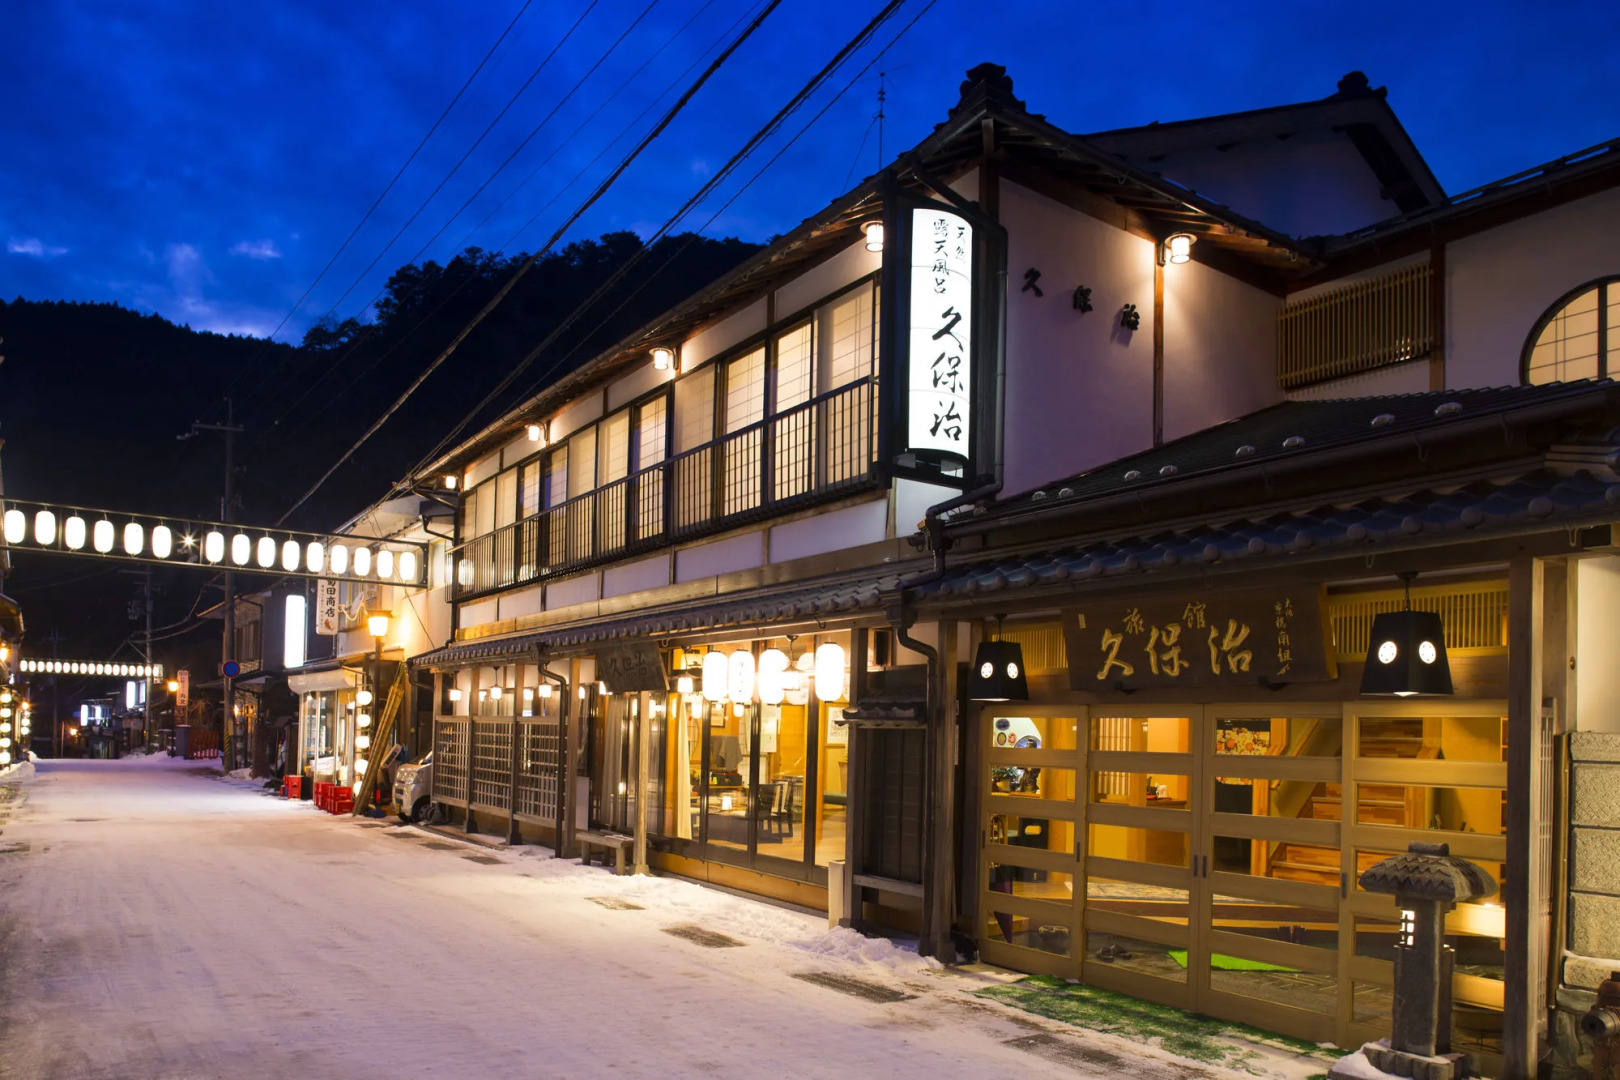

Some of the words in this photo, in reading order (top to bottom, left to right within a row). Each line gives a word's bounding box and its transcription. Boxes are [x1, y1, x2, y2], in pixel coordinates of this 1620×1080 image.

[933, 219, 950, 294] 露天風呂
[1021, 268, 1140, 331] 久保治
[930, 306, 964, 441] 久保治
[1097, 619, 1252, 680] 久保治
[1123, 602, 1207, 635] 旅館
